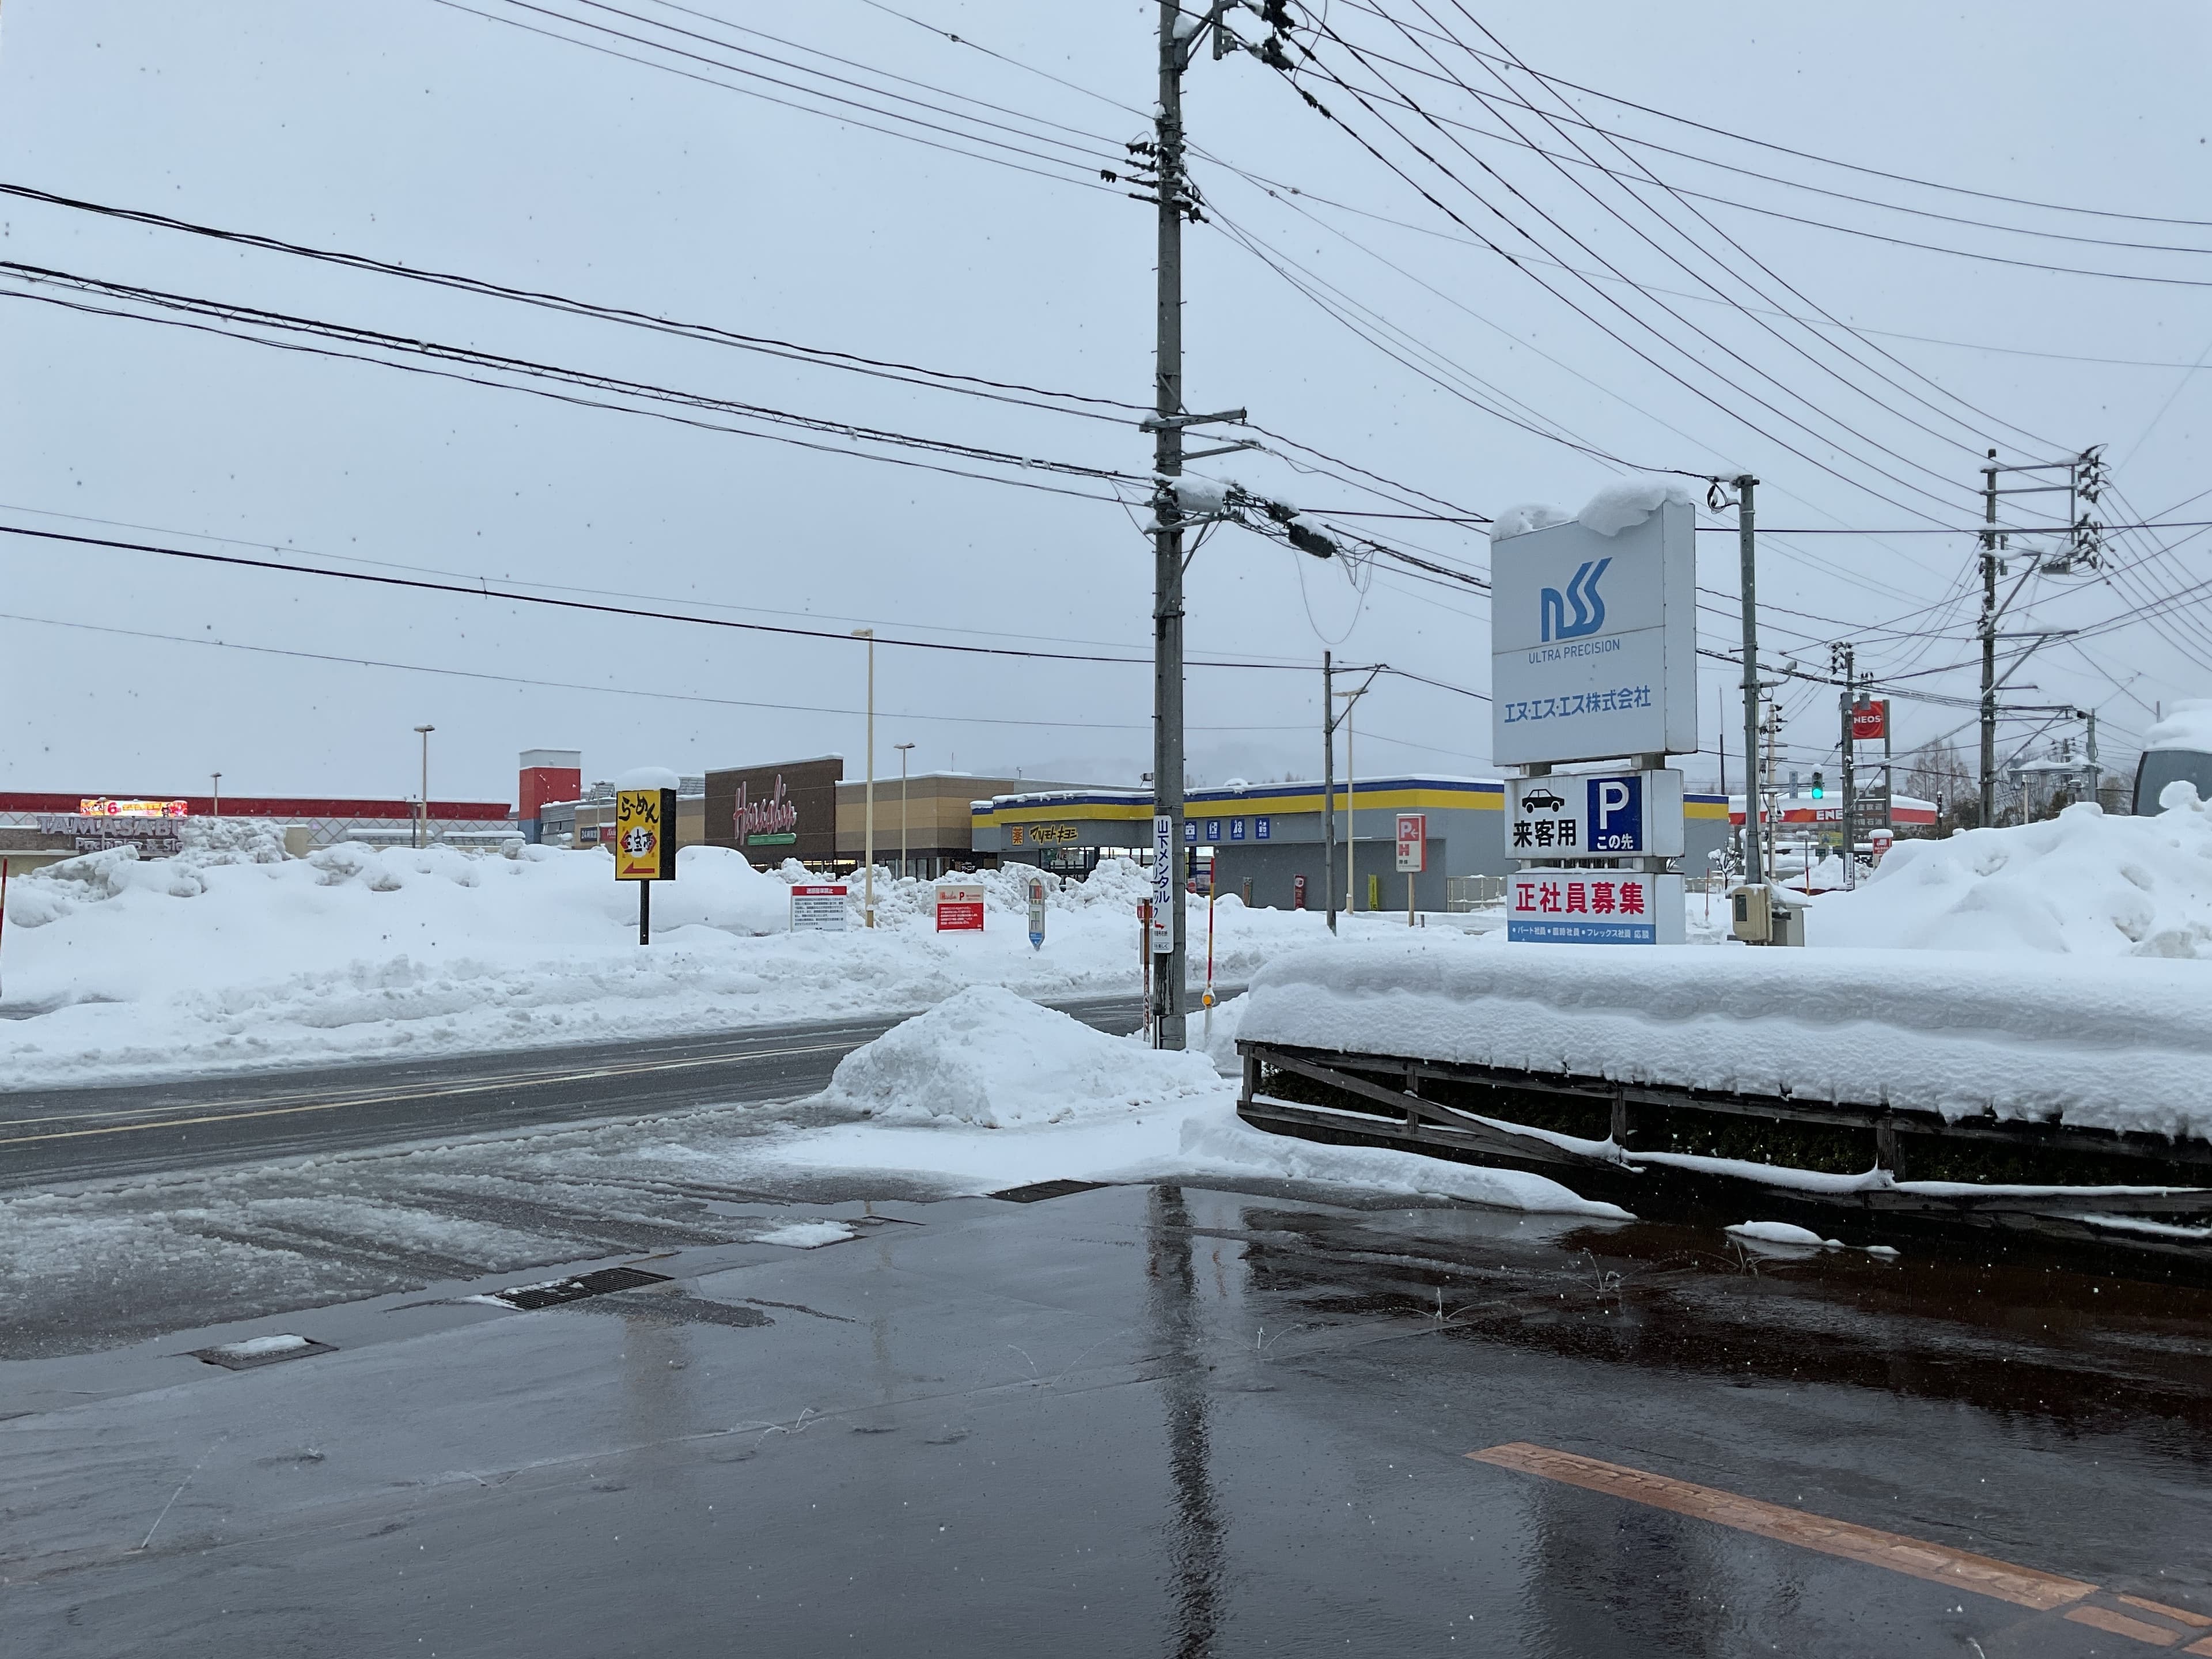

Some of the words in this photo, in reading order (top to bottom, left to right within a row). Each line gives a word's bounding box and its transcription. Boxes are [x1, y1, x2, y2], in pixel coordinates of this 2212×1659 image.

[1528, 646, 1561, 664] ULTRA
[1564, 639, 1620, 660] PRECISION
[1504, 685, 1652, 723] エヌ・エス・エス株式会社
[1853, 715, 1881, 724] NEOS
[618, 792, 660, 824] らーめん
[1599, 781, 1630, 830] P
[1816, 809, 1843, 820] ENE
[36, 816, 185, 836] TAMASAB
[1029, 825, 1078, 844] マツモトキヨシ
[1400, 821, 1412, 839] P
[1513, 819, 1577, 848] 来客用
[1597, 833, 1634, 850] この先
[1157, 819, 1170, 903] 山下メンタル
[959, 891, 965, 901] P
[1515, 881, 1645, 915] 正社員募集
